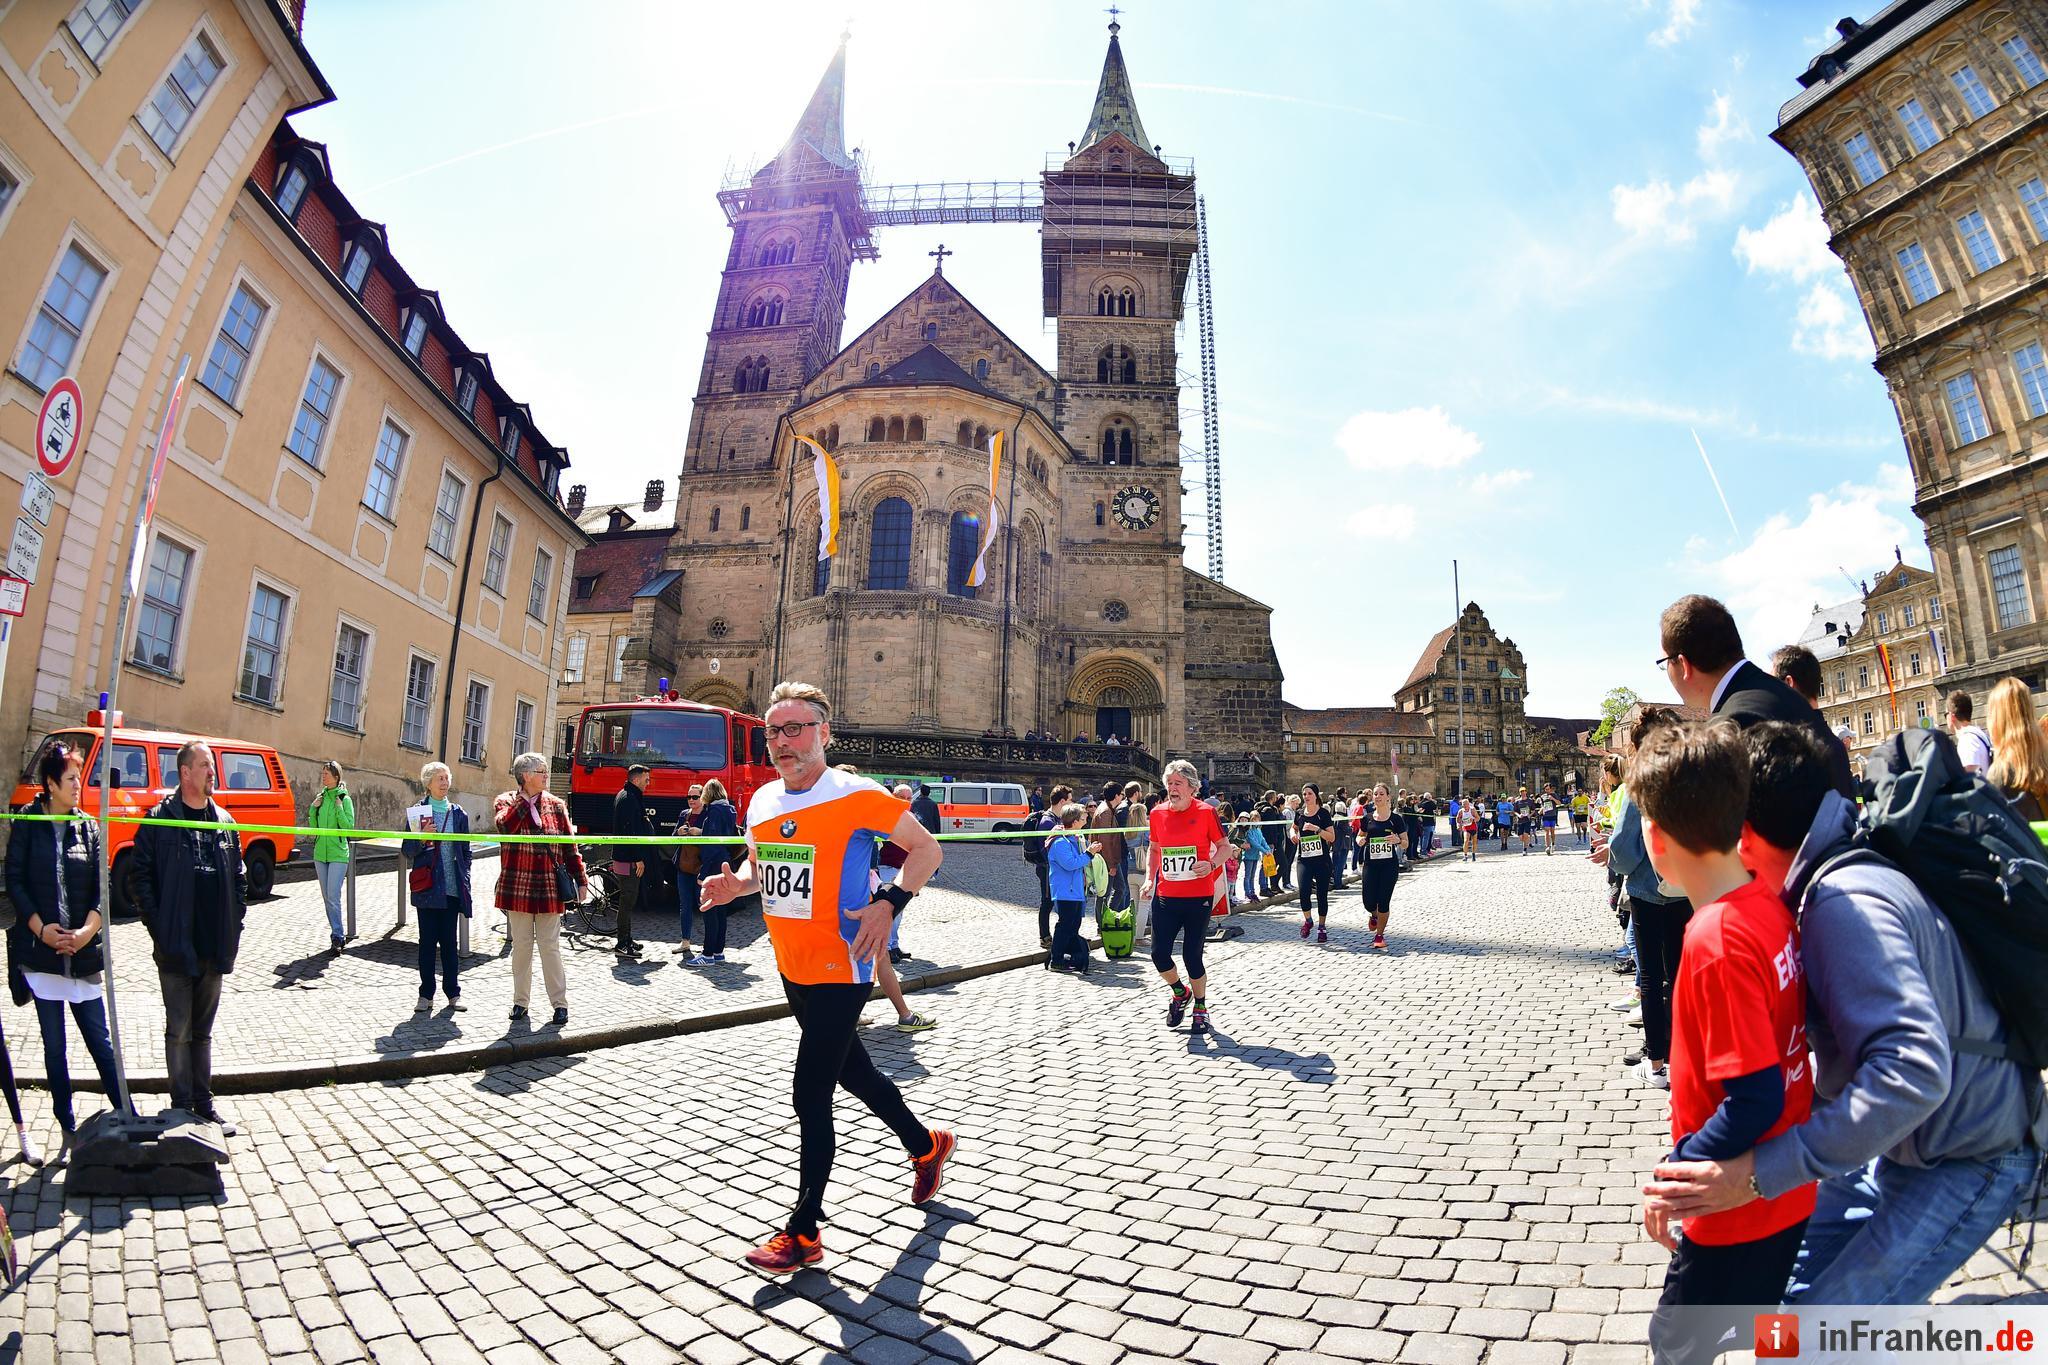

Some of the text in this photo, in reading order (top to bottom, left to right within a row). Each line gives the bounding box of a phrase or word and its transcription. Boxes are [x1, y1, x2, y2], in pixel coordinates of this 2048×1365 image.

[30, 498, 42, 517] frei
[19, 523, 39, 546] Linien-
[14, 542, 38, 565] verkehr
[16, 558, 28, 577] frei
[766, 847, 809, 860] wieland
[1301, 840, 1322, 852] 8330
[1370, 843, 1392, 854] 8845
[1163, 856, 1196, 872] 8172
